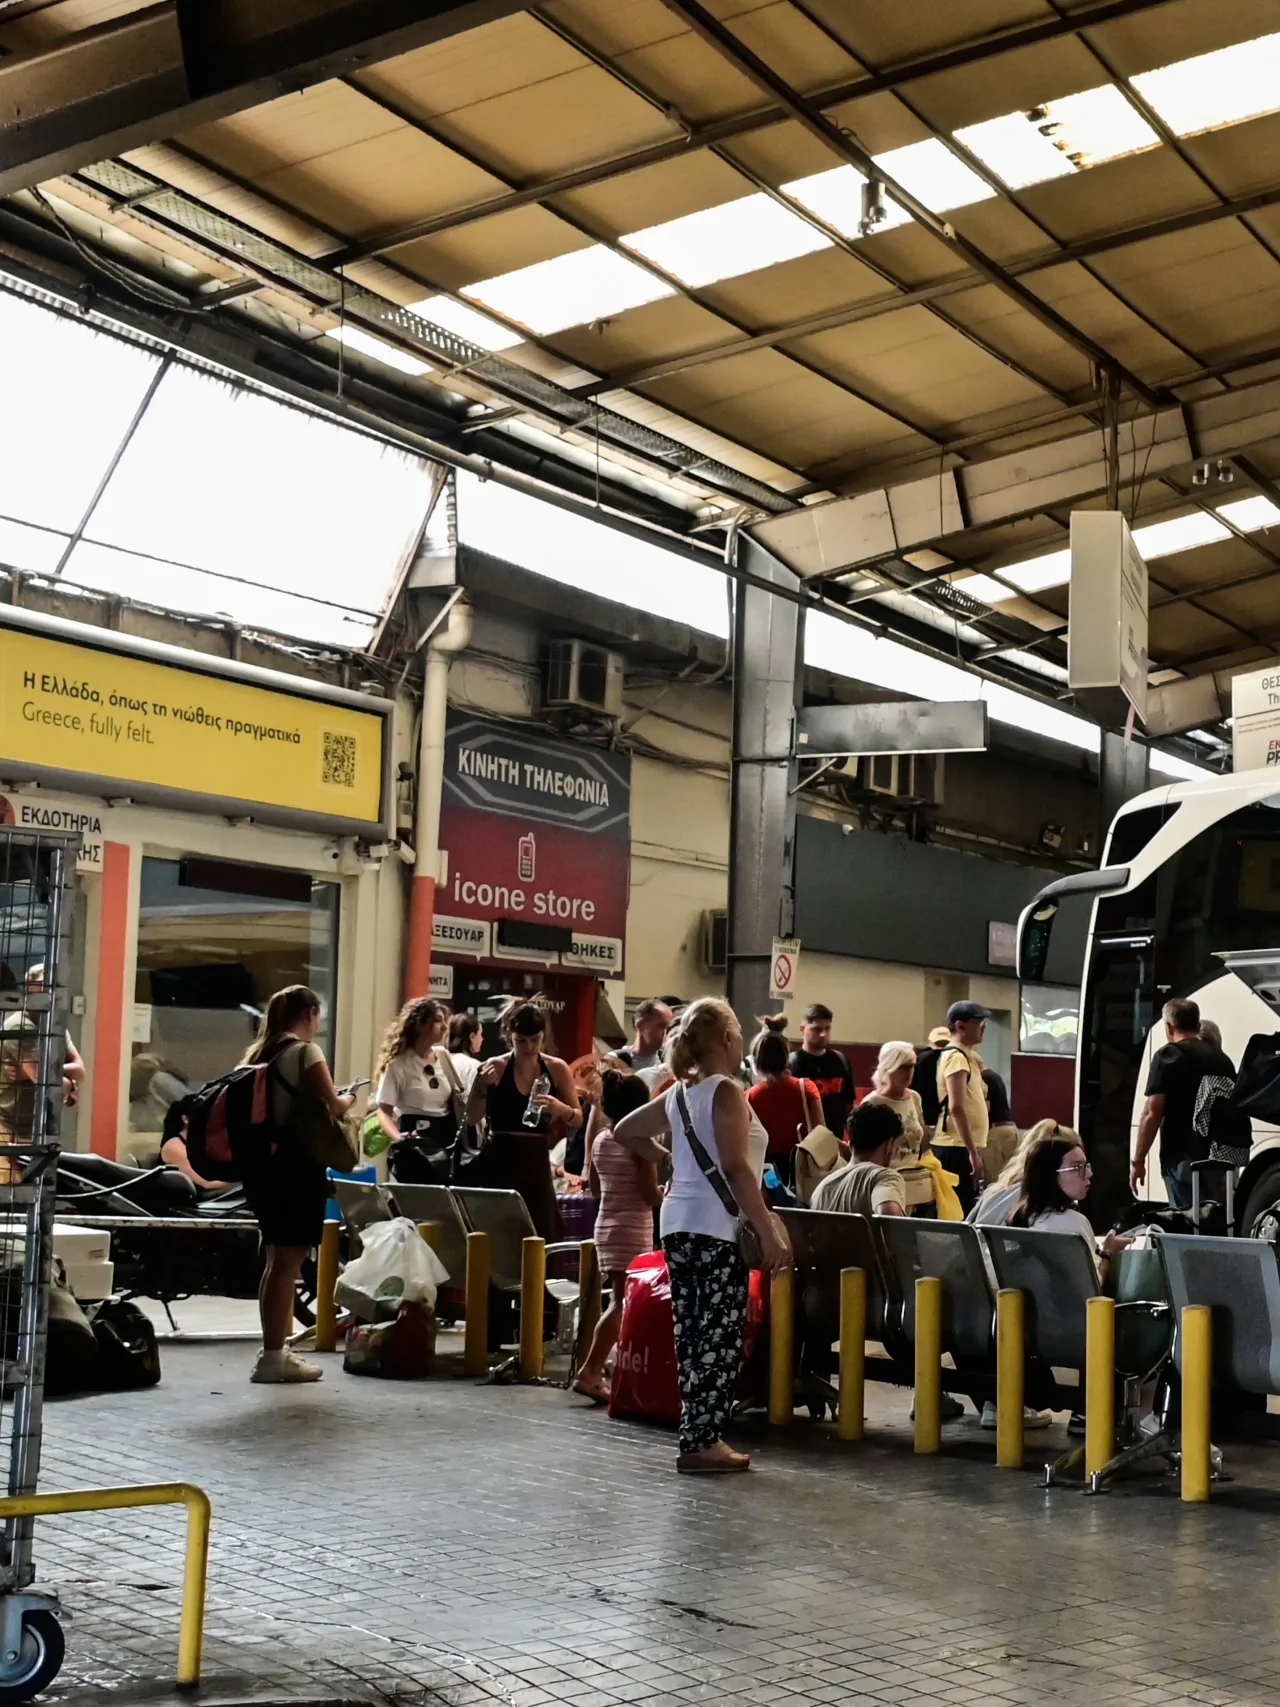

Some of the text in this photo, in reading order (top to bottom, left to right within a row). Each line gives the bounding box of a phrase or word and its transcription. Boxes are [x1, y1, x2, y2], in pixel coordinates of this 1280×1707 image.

[22, 702, 154, 745] Greece, fully felt.
[24, 671, 301, 744] Η Ελλάδα, όπως τη νιώθεις πραγματικά
[458, 748, 609, 807] ΚΙΝΗΤΗ ΤΗΛΕΦΩΝΙΑ
[21, 806, 102, 834] ΕΚΔΟΤΗΡΙΑ
[454, 872, 596, 922] icone store
[571, 942, 614, 960] ΘΗΚΕΣ
